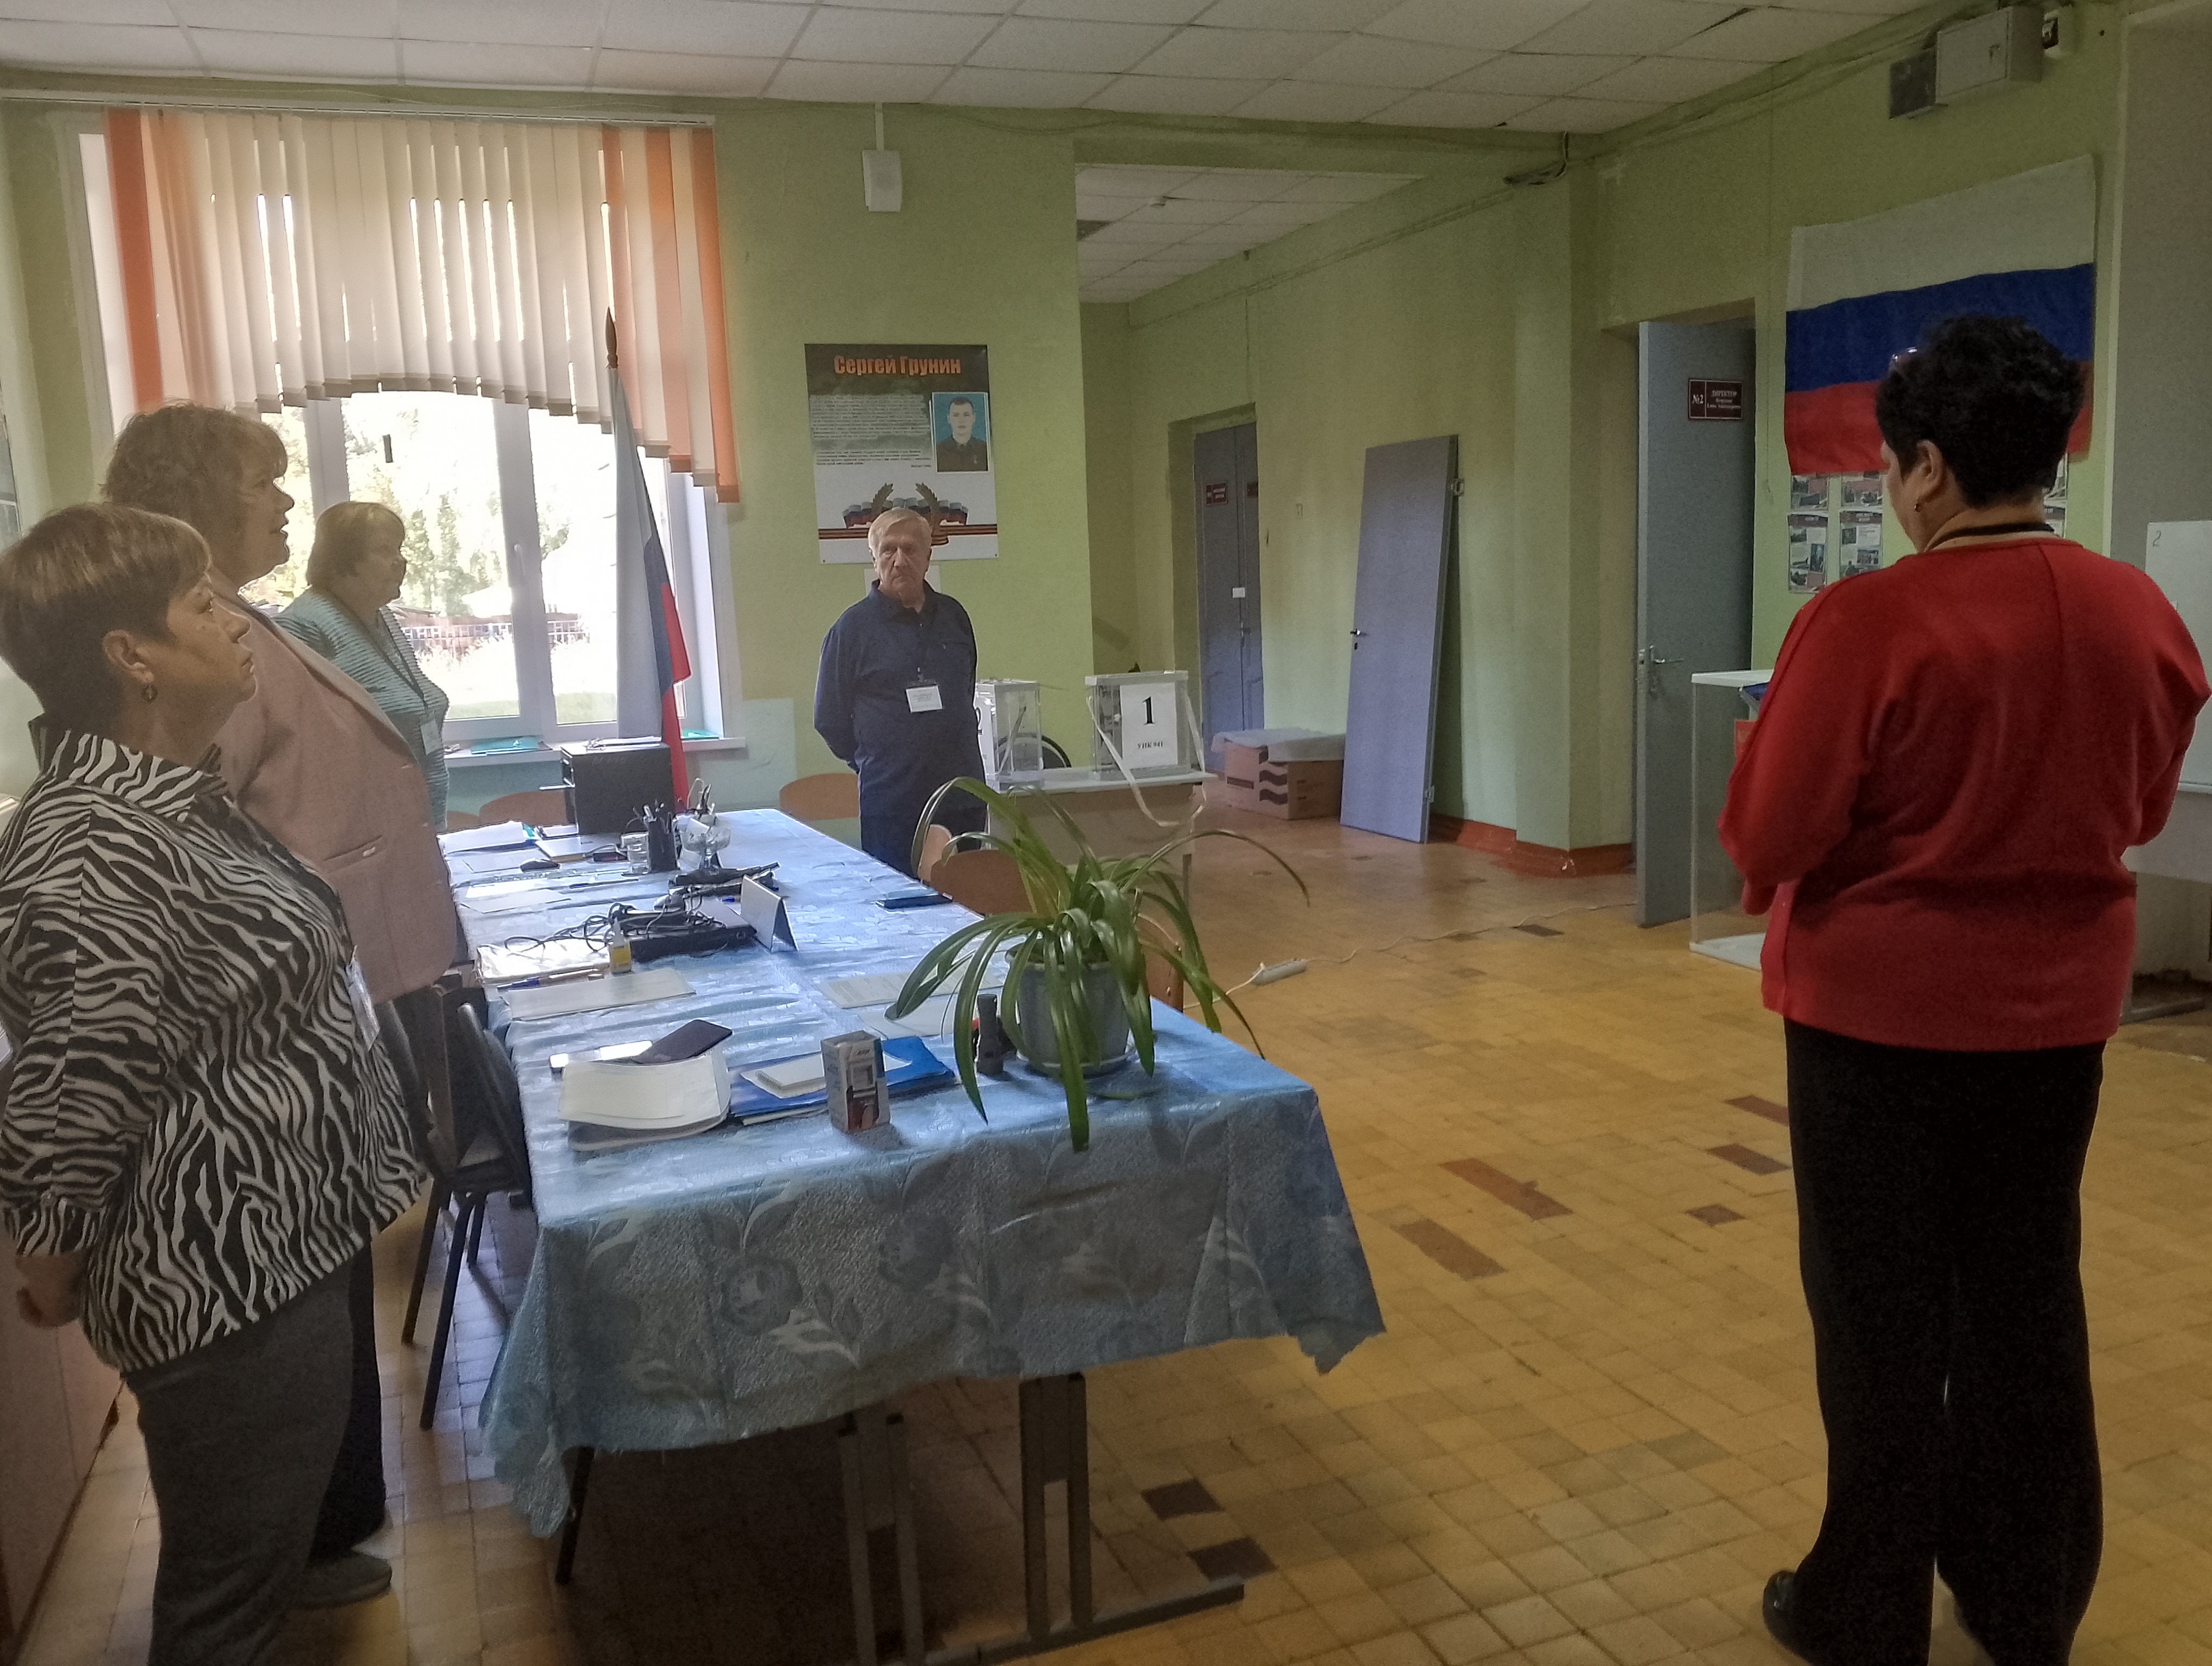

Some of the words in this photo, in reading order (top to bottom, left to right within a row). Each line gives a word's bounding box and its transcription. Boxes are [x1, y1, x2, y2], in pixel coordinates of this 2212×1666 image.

[834, 355, 896, 376] Сергей
[900, 356, 961, 376] Грунин
[1692, 394, 1704, 405] №2
[1142, 696, 1156, 726] 1
